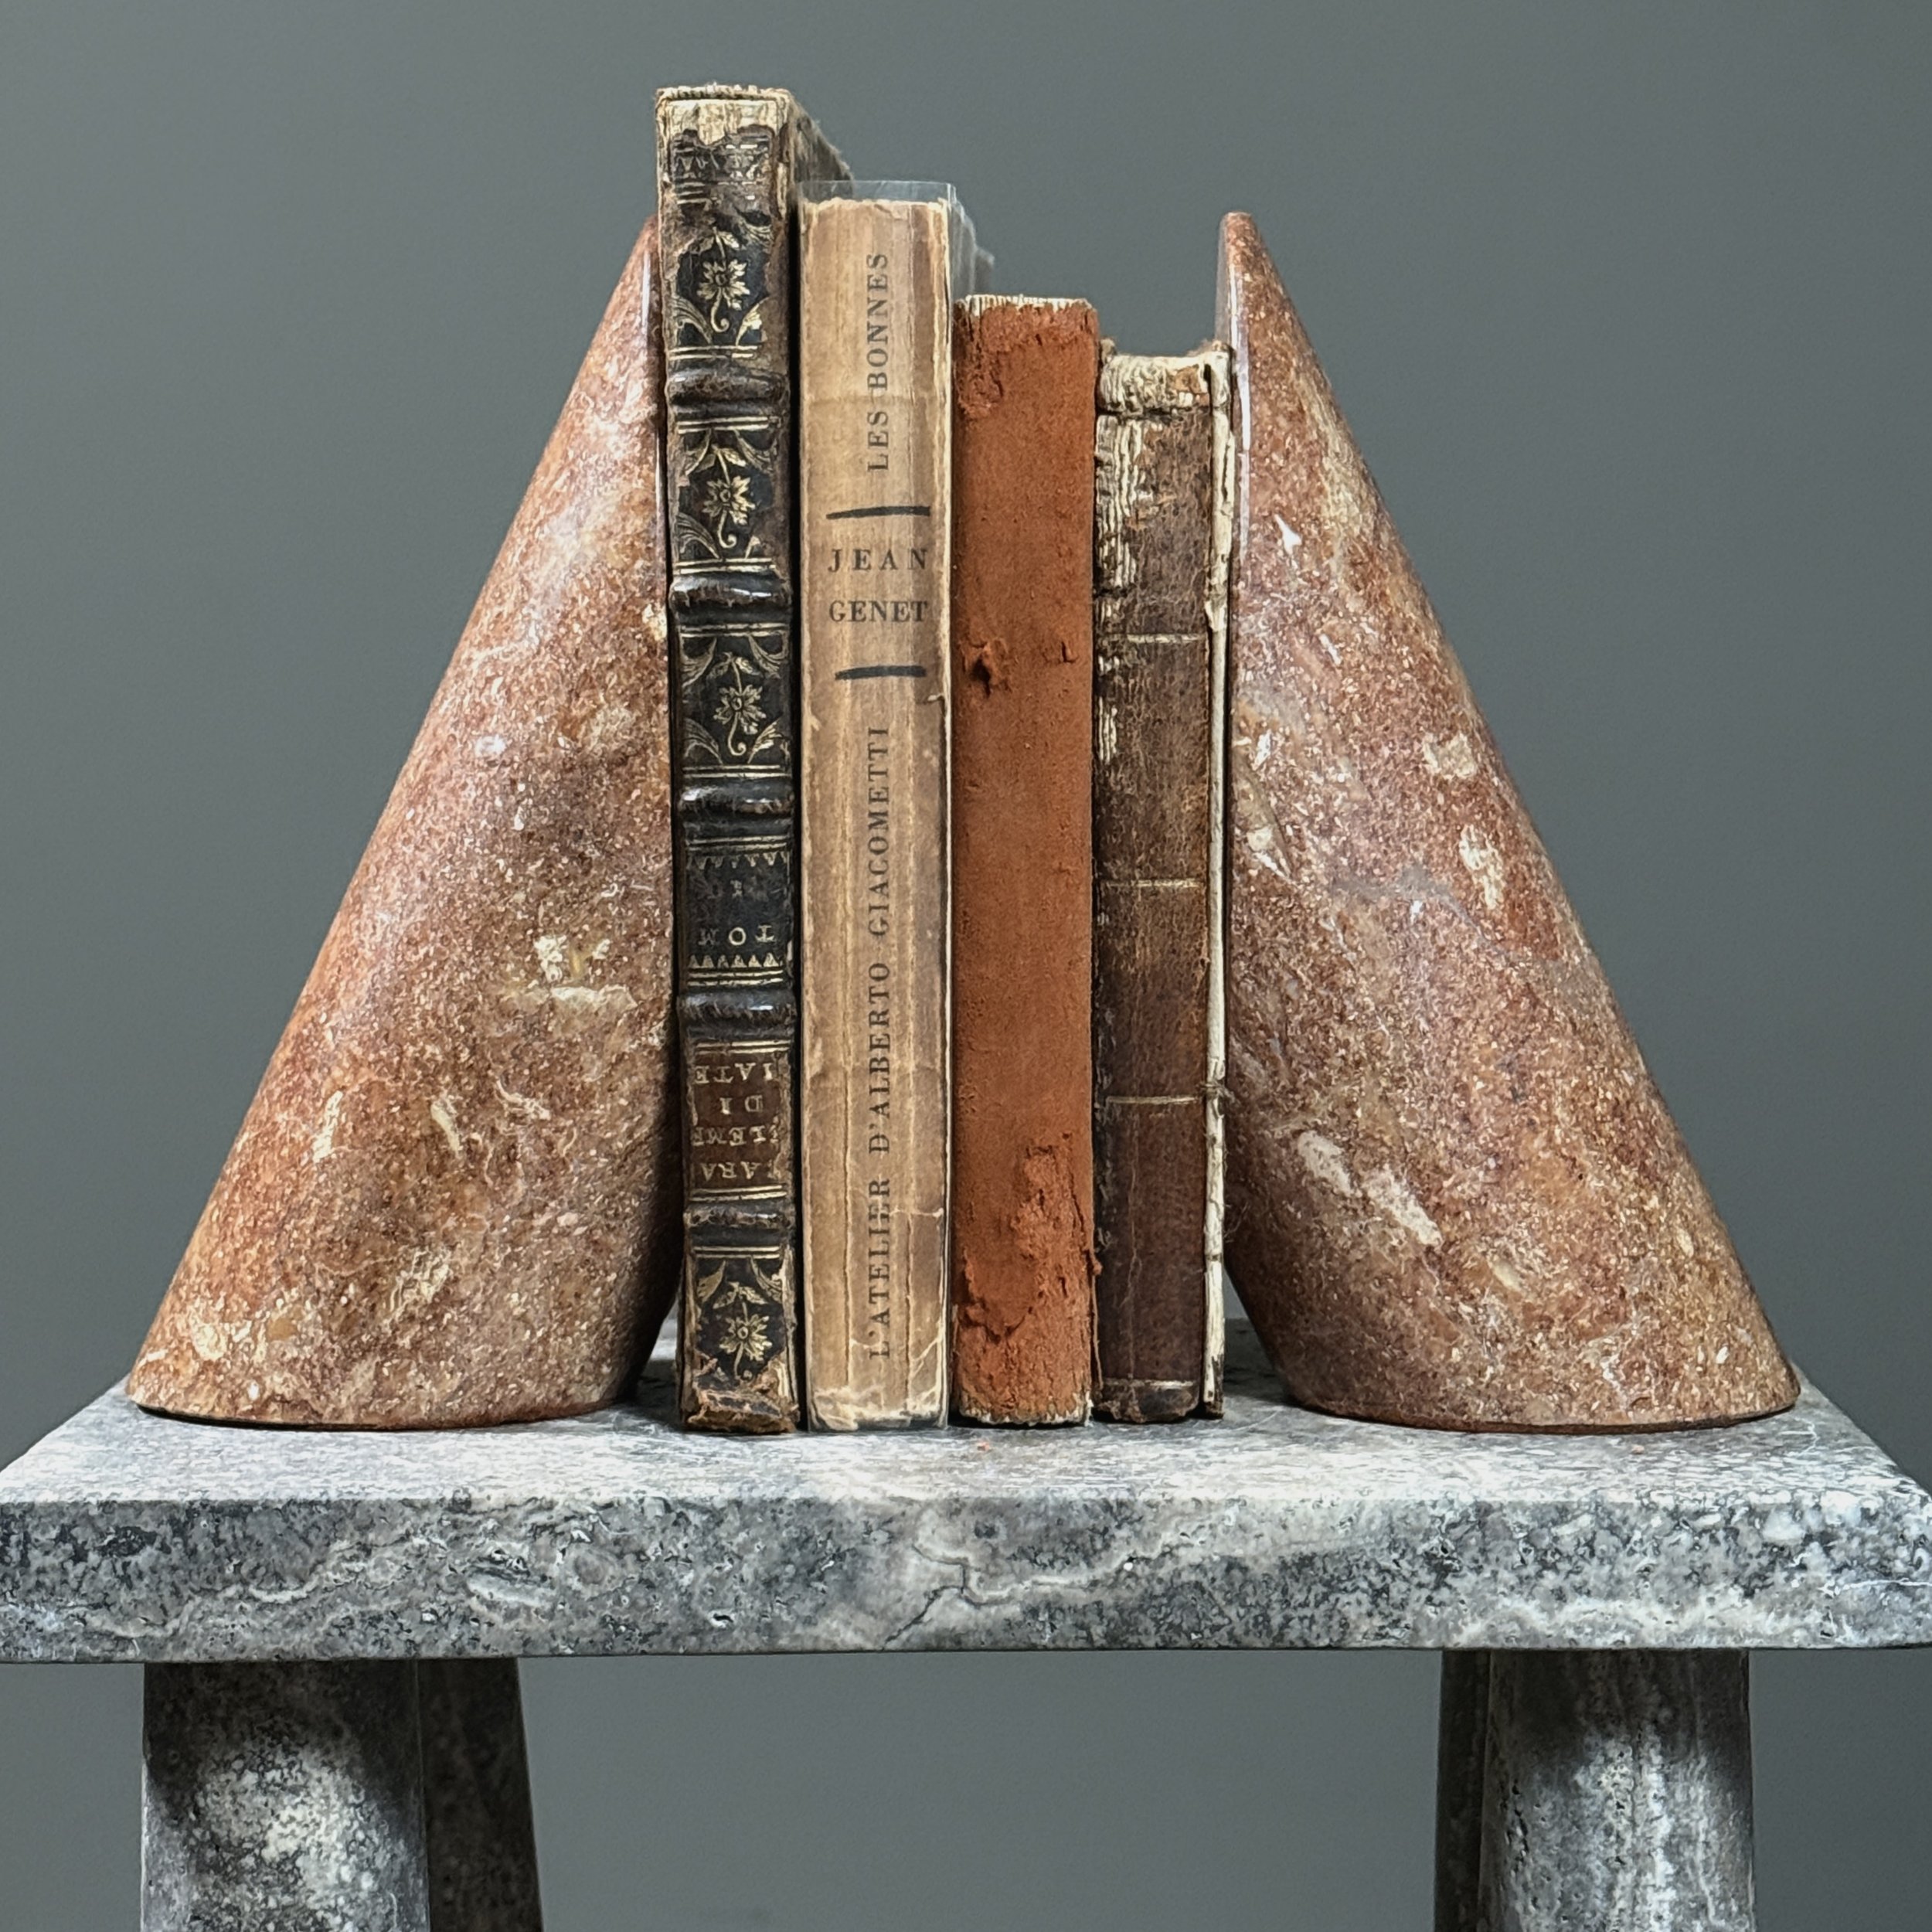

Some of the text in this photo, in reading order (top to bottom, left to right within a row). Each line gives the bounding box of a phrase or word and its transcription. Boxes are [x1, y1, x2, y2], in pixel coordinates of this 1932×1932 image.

[866, 253, 889, 473] LES BONNES
[827, 547, 927, 573] JEAN
[828, 599, 928, 623] GENET
[867, 726, 891, 1361] L'ATELIER D'ALBERTO GIACOMETTI
